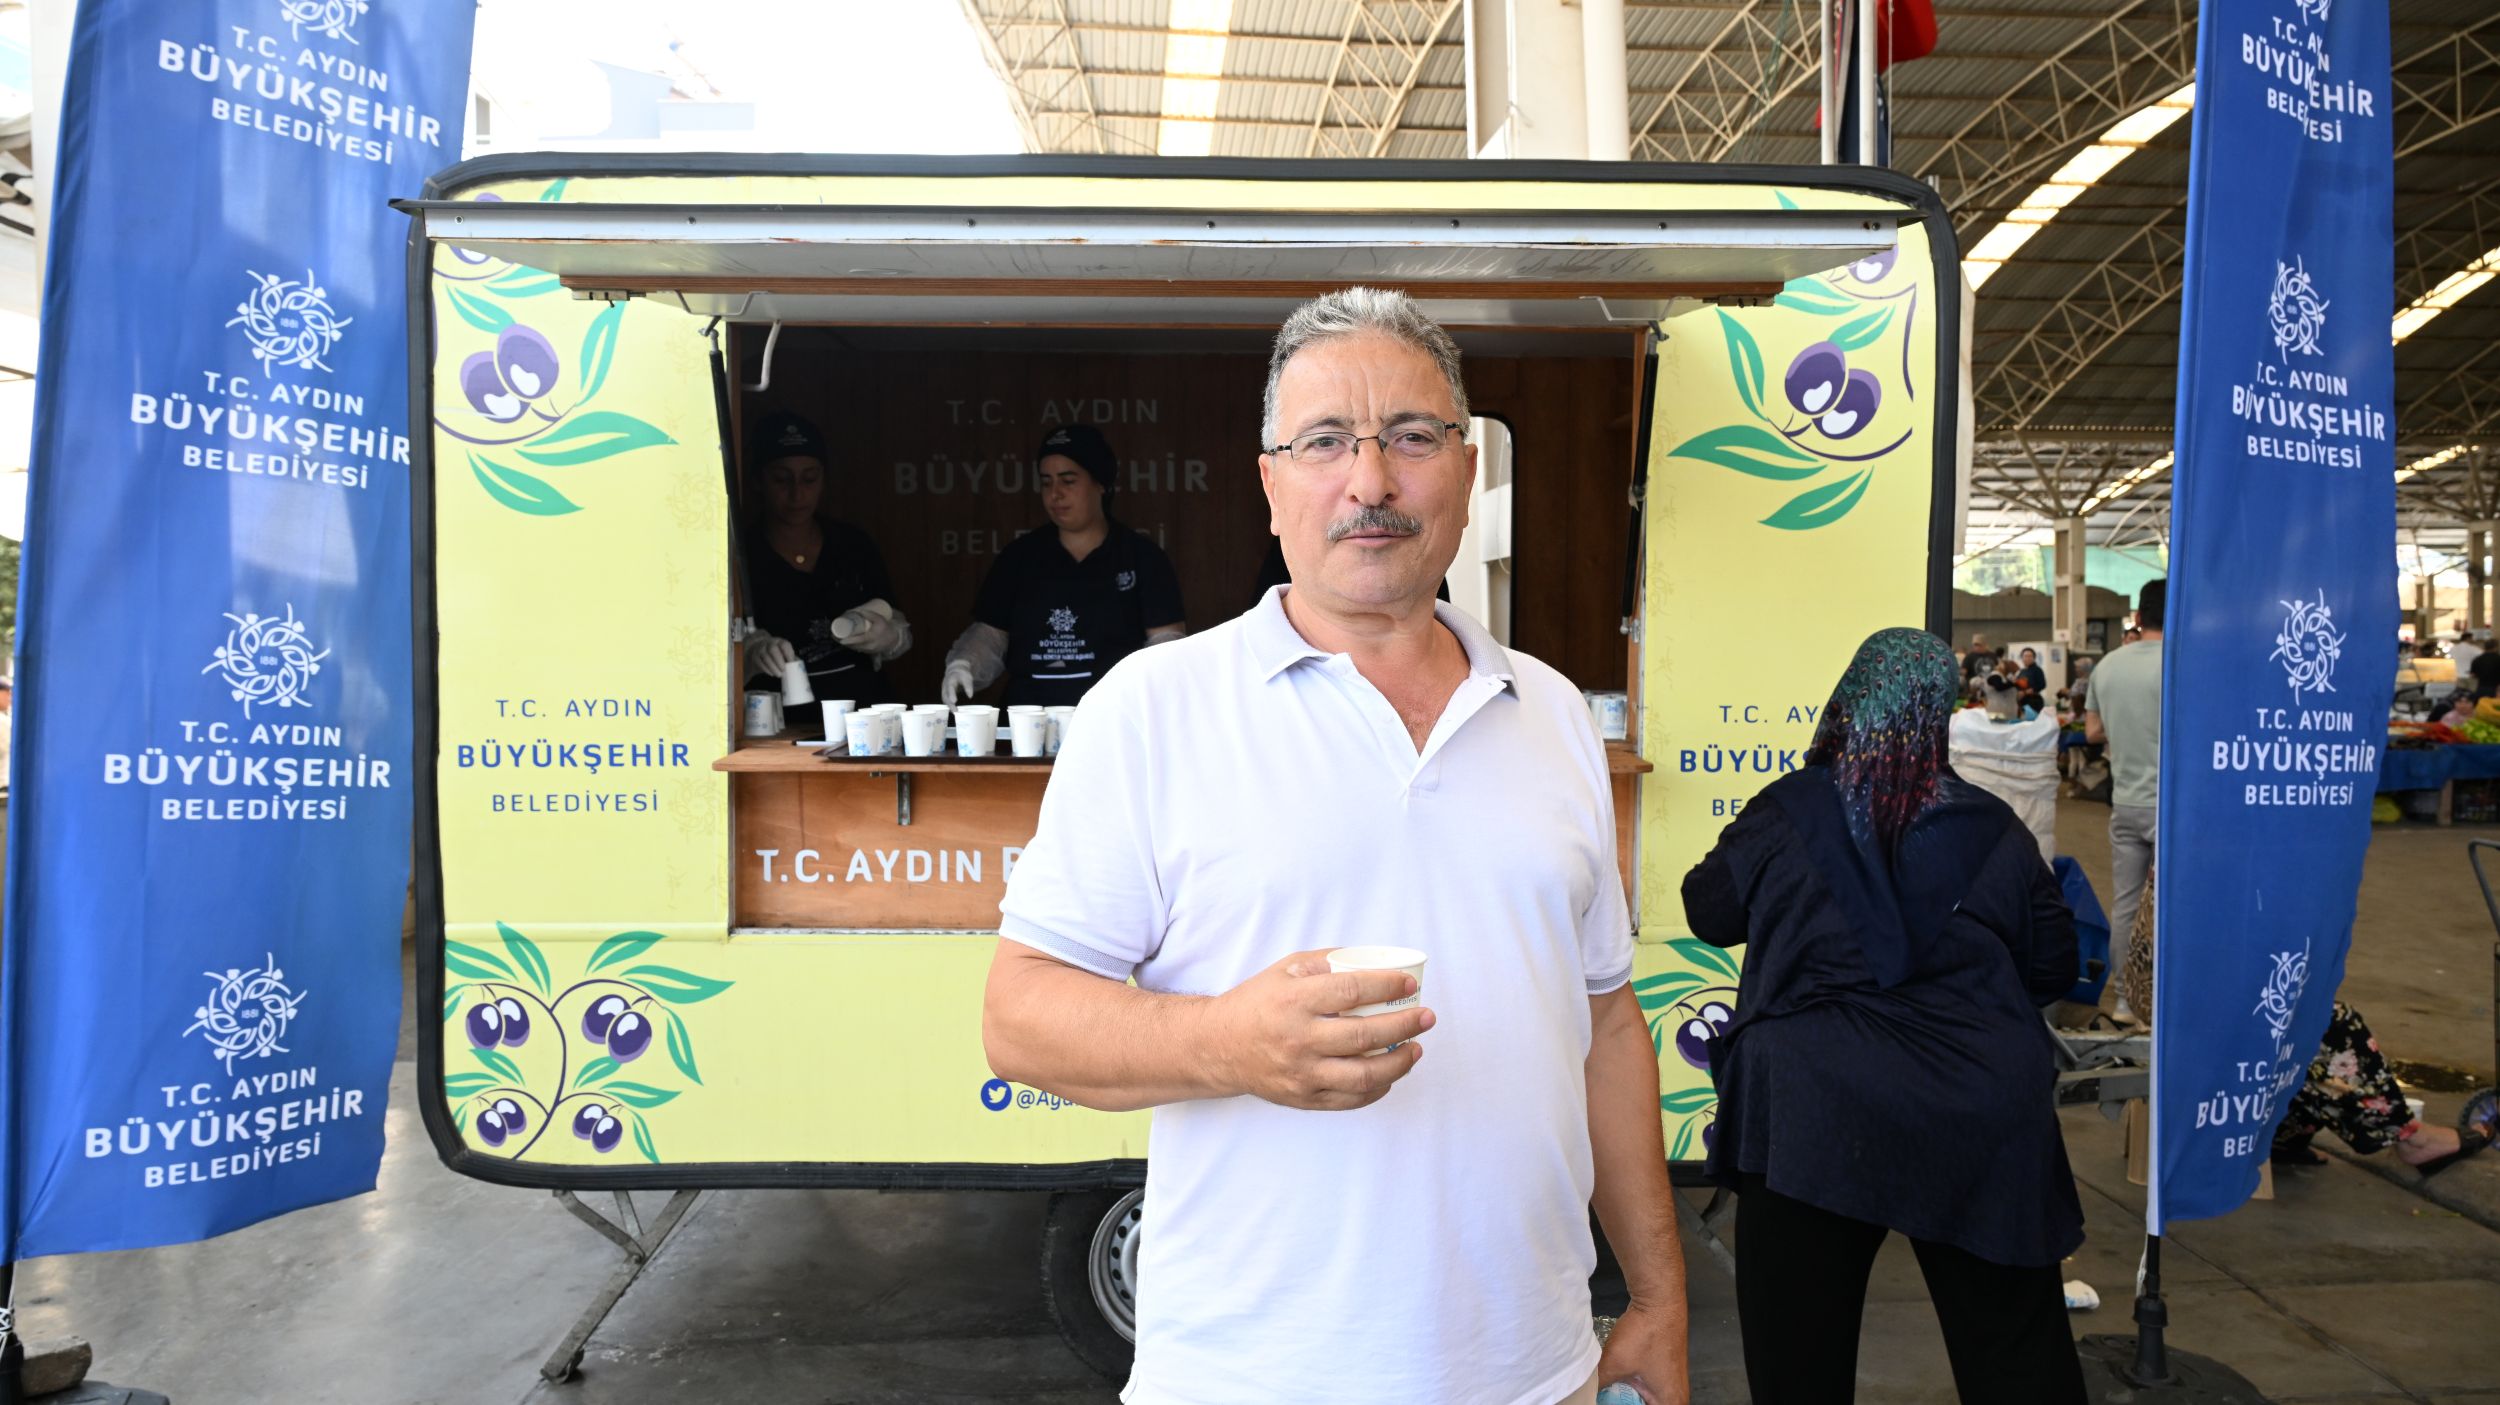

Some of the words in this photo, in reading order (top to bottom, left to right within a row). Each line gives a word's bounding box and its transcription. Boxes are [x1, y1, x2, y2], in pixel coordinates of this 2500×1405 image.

[2272, 16, 2303, 46] T.C.
[231, 26, 286, 62] T.C.
[298, 52, 388, 92] AYDIN
[158, 40, 441, 147] BÜYÜKŞEHİR
[211, 98, 393, 164] BELEDİYESİ
[203, 371, 259, 400] T.C.
[270, 383, 364, 416] AYDIN
[2289, 369, 2348, 397] AYDIN
[130, 392, 411, 465] BÜYÜKŞEHİR
[945, 400, 1016, 424] T.C.
[1040, 399, 1159, 424] AYDIN
[183, 445, 367, 489] BELEDİYESİ
[2247, 435, 2361, 469] BELEDİYESİ
[495, 700, 547, 717] T.C.
[564, 699, 652, 717] AYDIN
[1719, 706, 1768, 723] T.C.
[2257, 708, 2292, 730] T.C.
[2299, 710, 2353, 731] AYDIN
[179, 720, 239, 744] T.C.
[249, 723, 342, 747] AYDIN
[103, 748, 391, 795] BÜYÜKŞEHİR
[457, 738, 690, 774] BÜYÜKŞEHİR
[2212, 734, 2376, 780] BÜYÜKŞEHİR
[161, 795, 347, 820] BELEDİYESİ
[492, 790, 658, 812] BELEDİYESİ
[2244, 781, 2354, 806] BELEDİYESİ
[755, 849, 834, 883] T.C.
[845, 849, 982, 883] AYDIN
[161, 1083, 221, 1108] T.C.
[231, 1066, 317, 1100] AYDIN
[2236, 1061, 2271, 1082] T.C.
[84, 1086, 363, 1158] BÜYÜKŞEHİR
[144, 1131, 321, 1188] BELEDİYESİ
